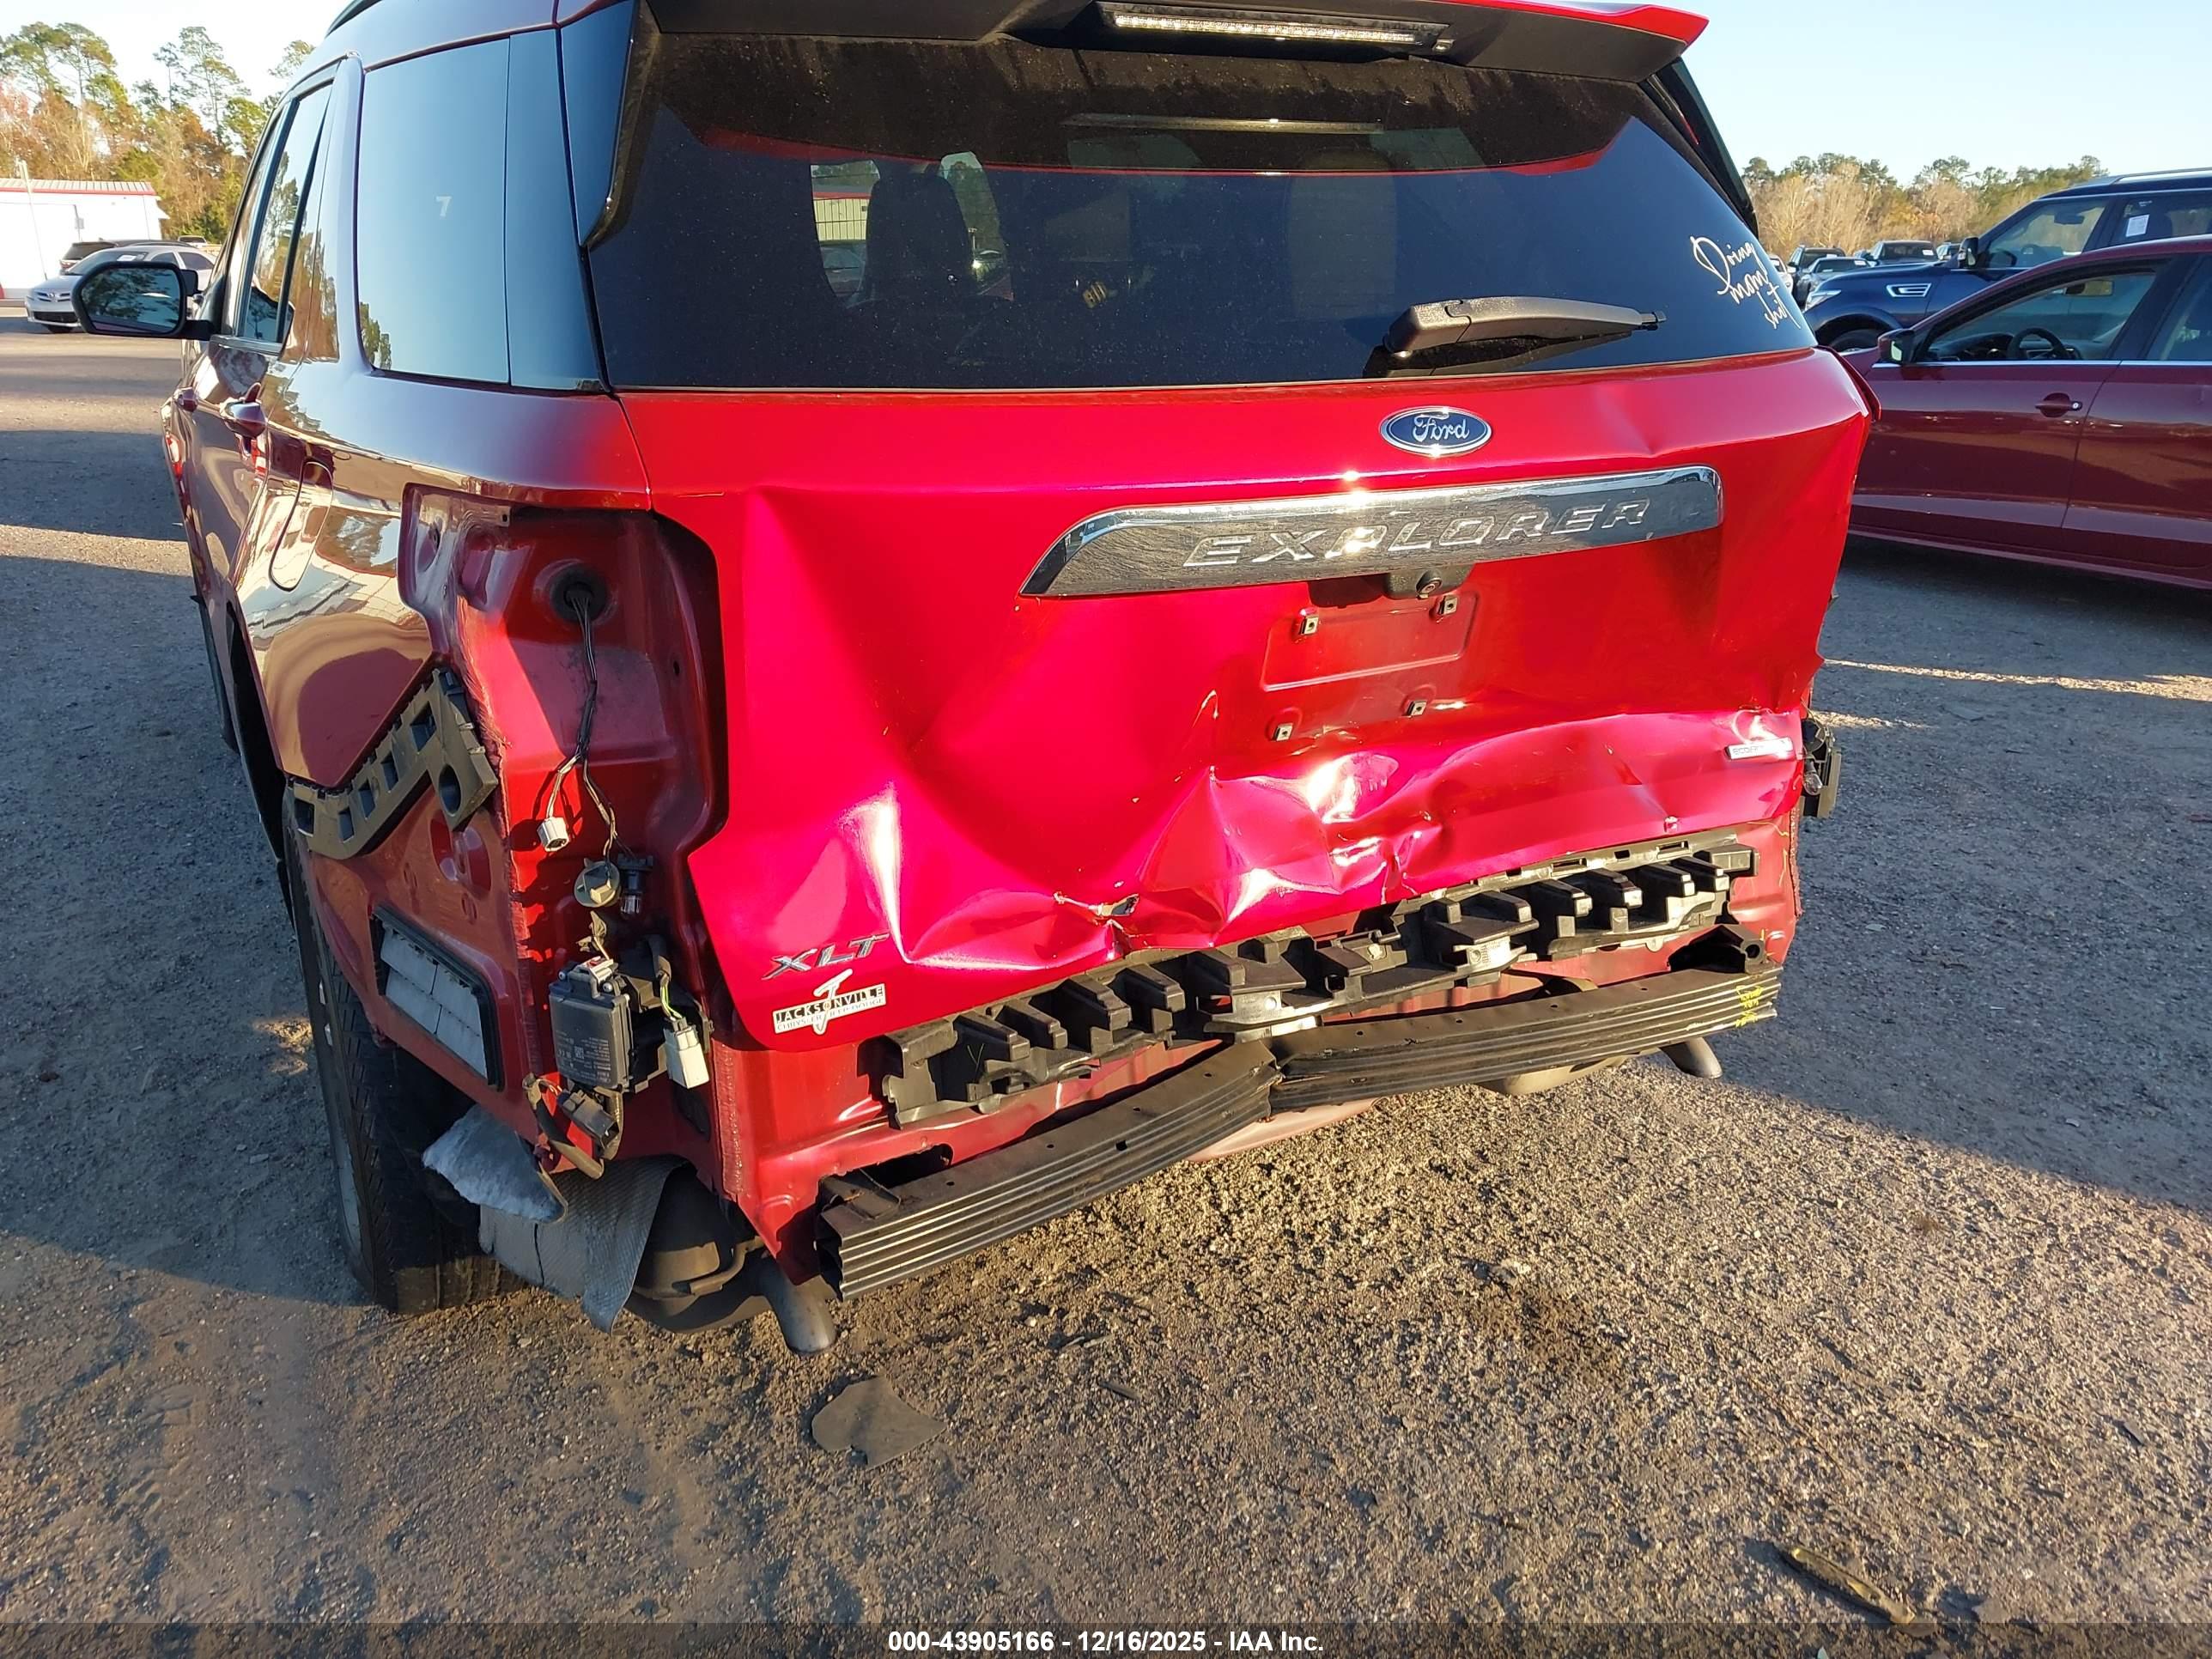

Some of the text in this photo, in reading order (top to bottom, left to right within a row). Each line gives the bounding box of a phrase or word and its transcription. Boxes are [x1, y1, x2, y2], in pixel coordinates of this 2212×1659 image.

[435, 195, 452, 218] 7
[1690, 236, 1769, 295] Doing
[1729, 270, 1769, 304] mom
[1756, 282, 1801, 329] shit
[1413, 411, 1470, 442] Ford
[1183, 497, 1650, 567] EXPLORER
[761, 933, 890, 981] XLT
[775, 986, 884, 1024] JACKSONVILLE
